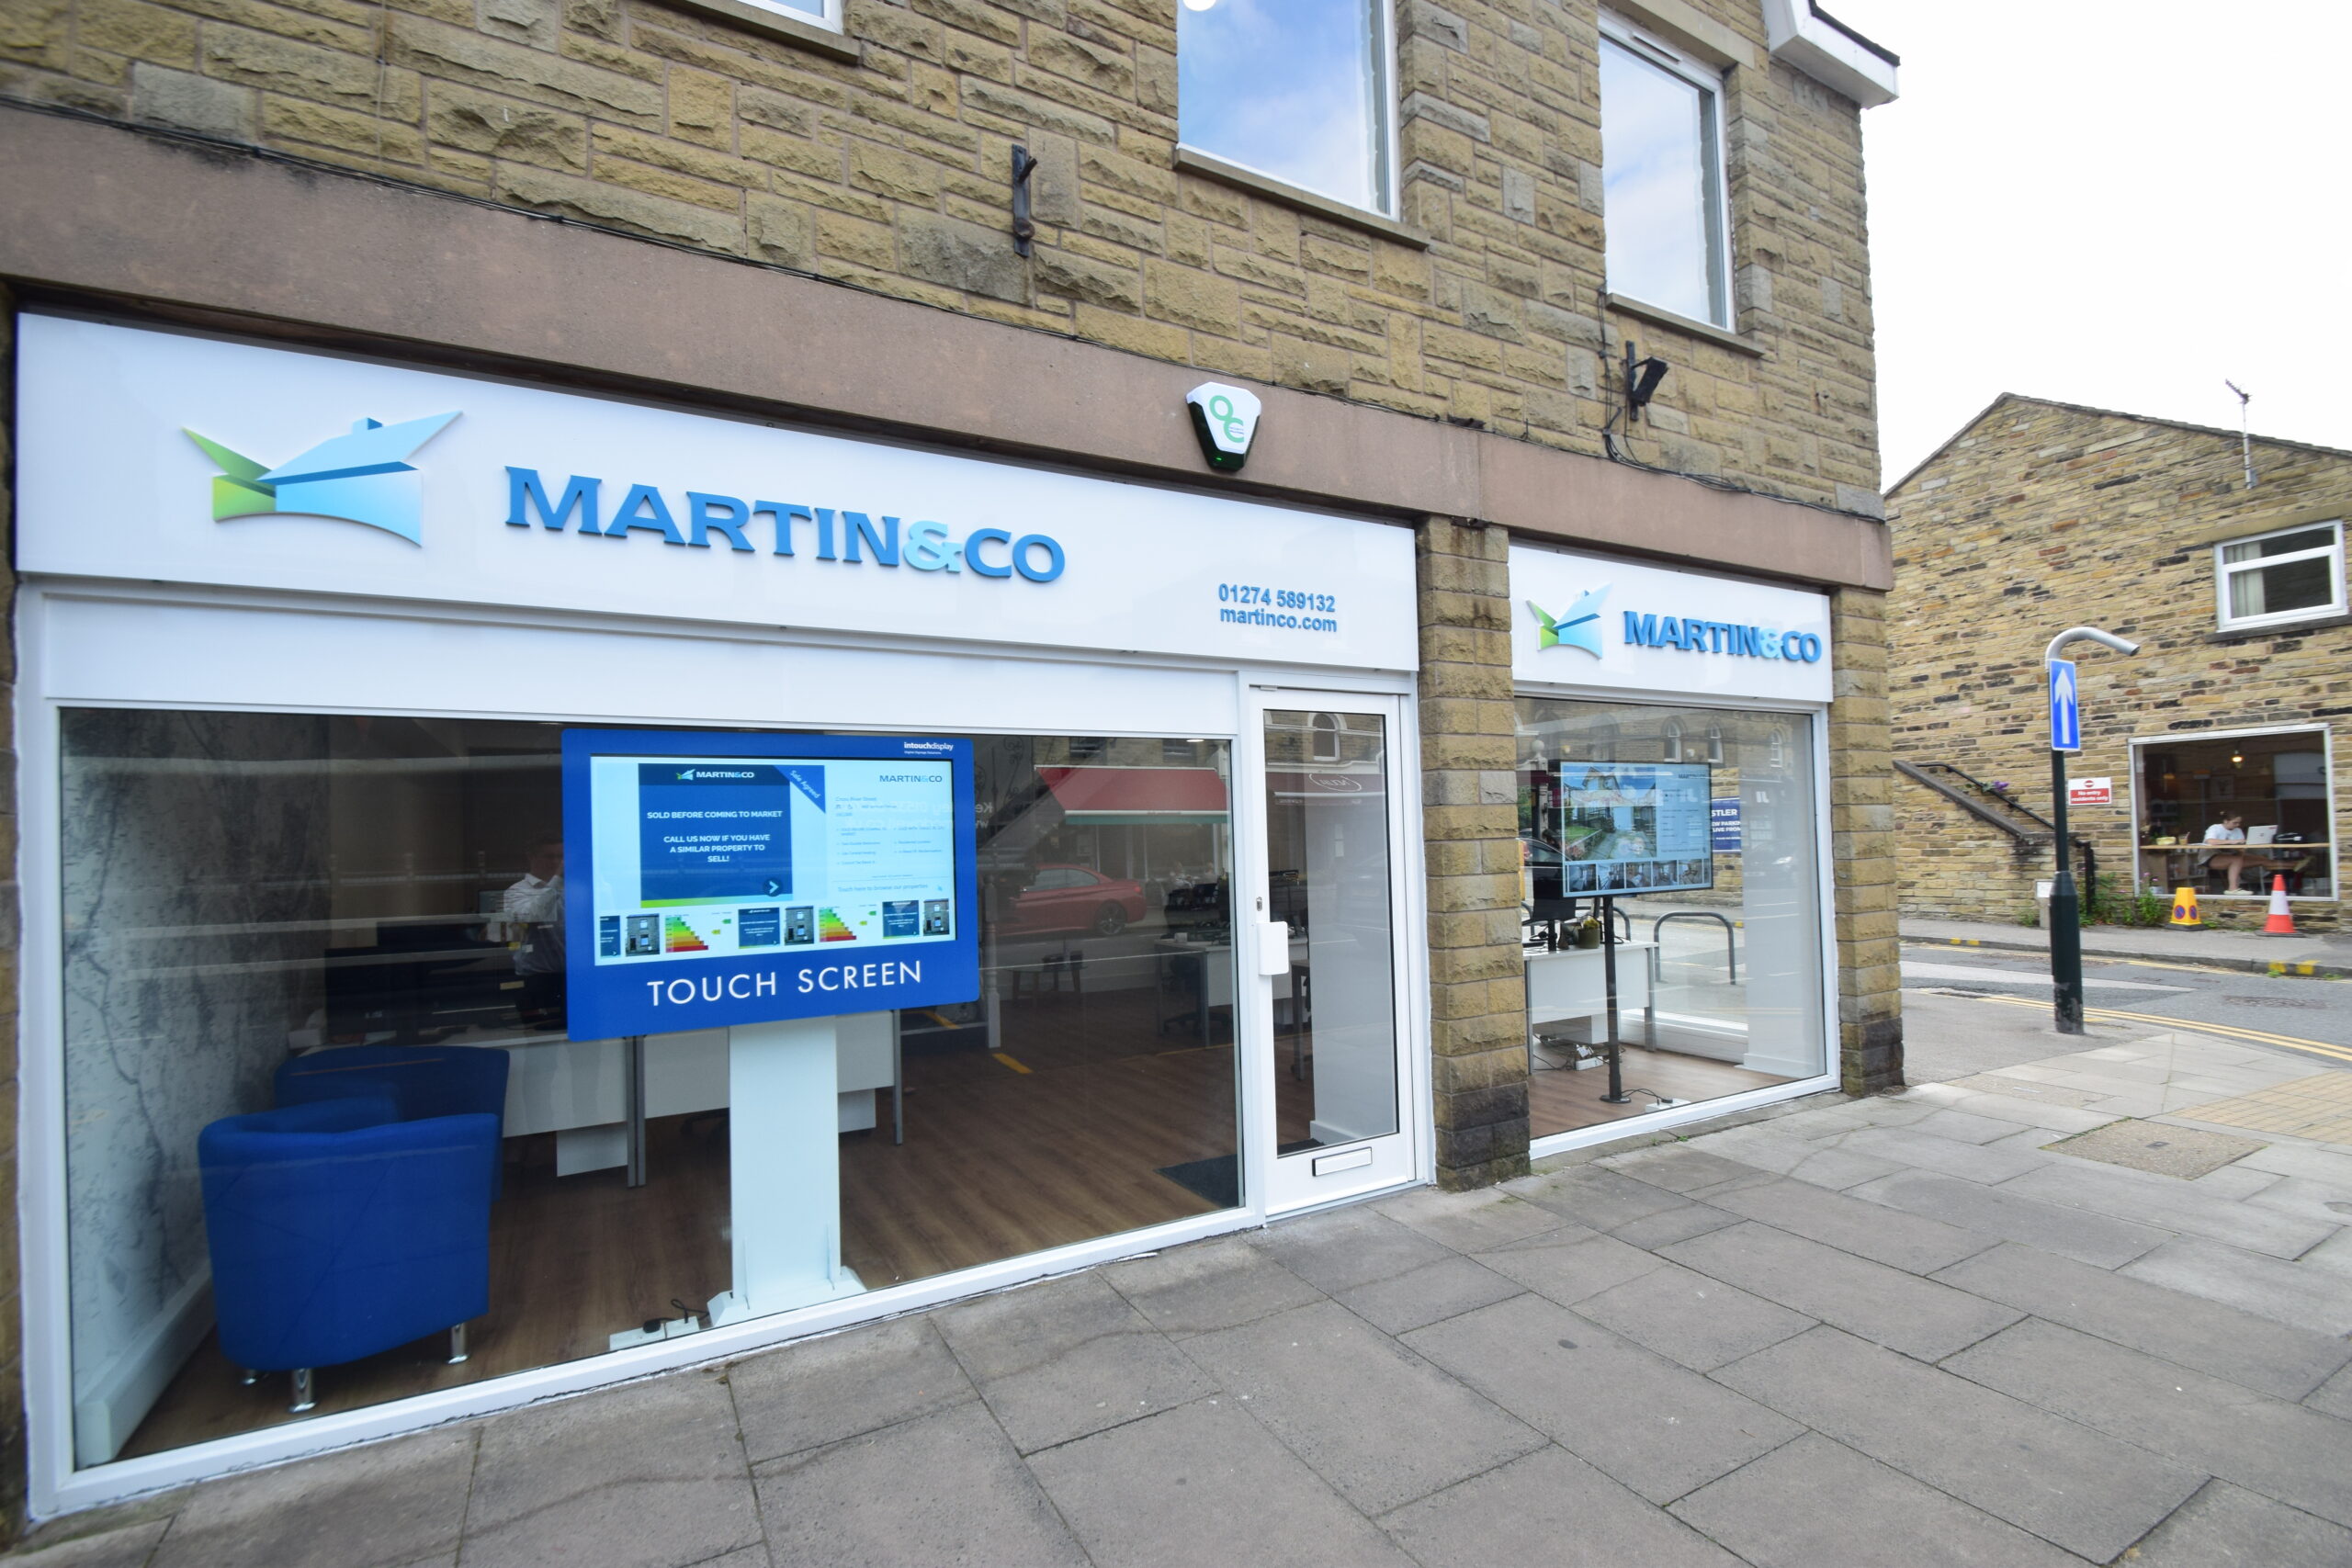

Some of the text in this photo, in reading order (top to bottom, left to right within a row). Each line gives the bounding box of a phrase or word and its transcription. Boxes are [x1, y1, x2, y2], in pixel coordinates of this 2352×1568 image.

[503, 465, 1066, 583] MARTIN&CO
[1218, 583, 1336, 613] 01274 589132
[1220, 607, 1338, 632] martinco.com
[1623, 610, 1823, 662] MARTIN&CO
[904, 742, 954, 751] intouchdisplay
[789, 770, 821, 799] Sale Agreed
[879, 774, 943, 783] MARTIN&CO
[647, 960, 921, 1006] TOUCH SCREEN
